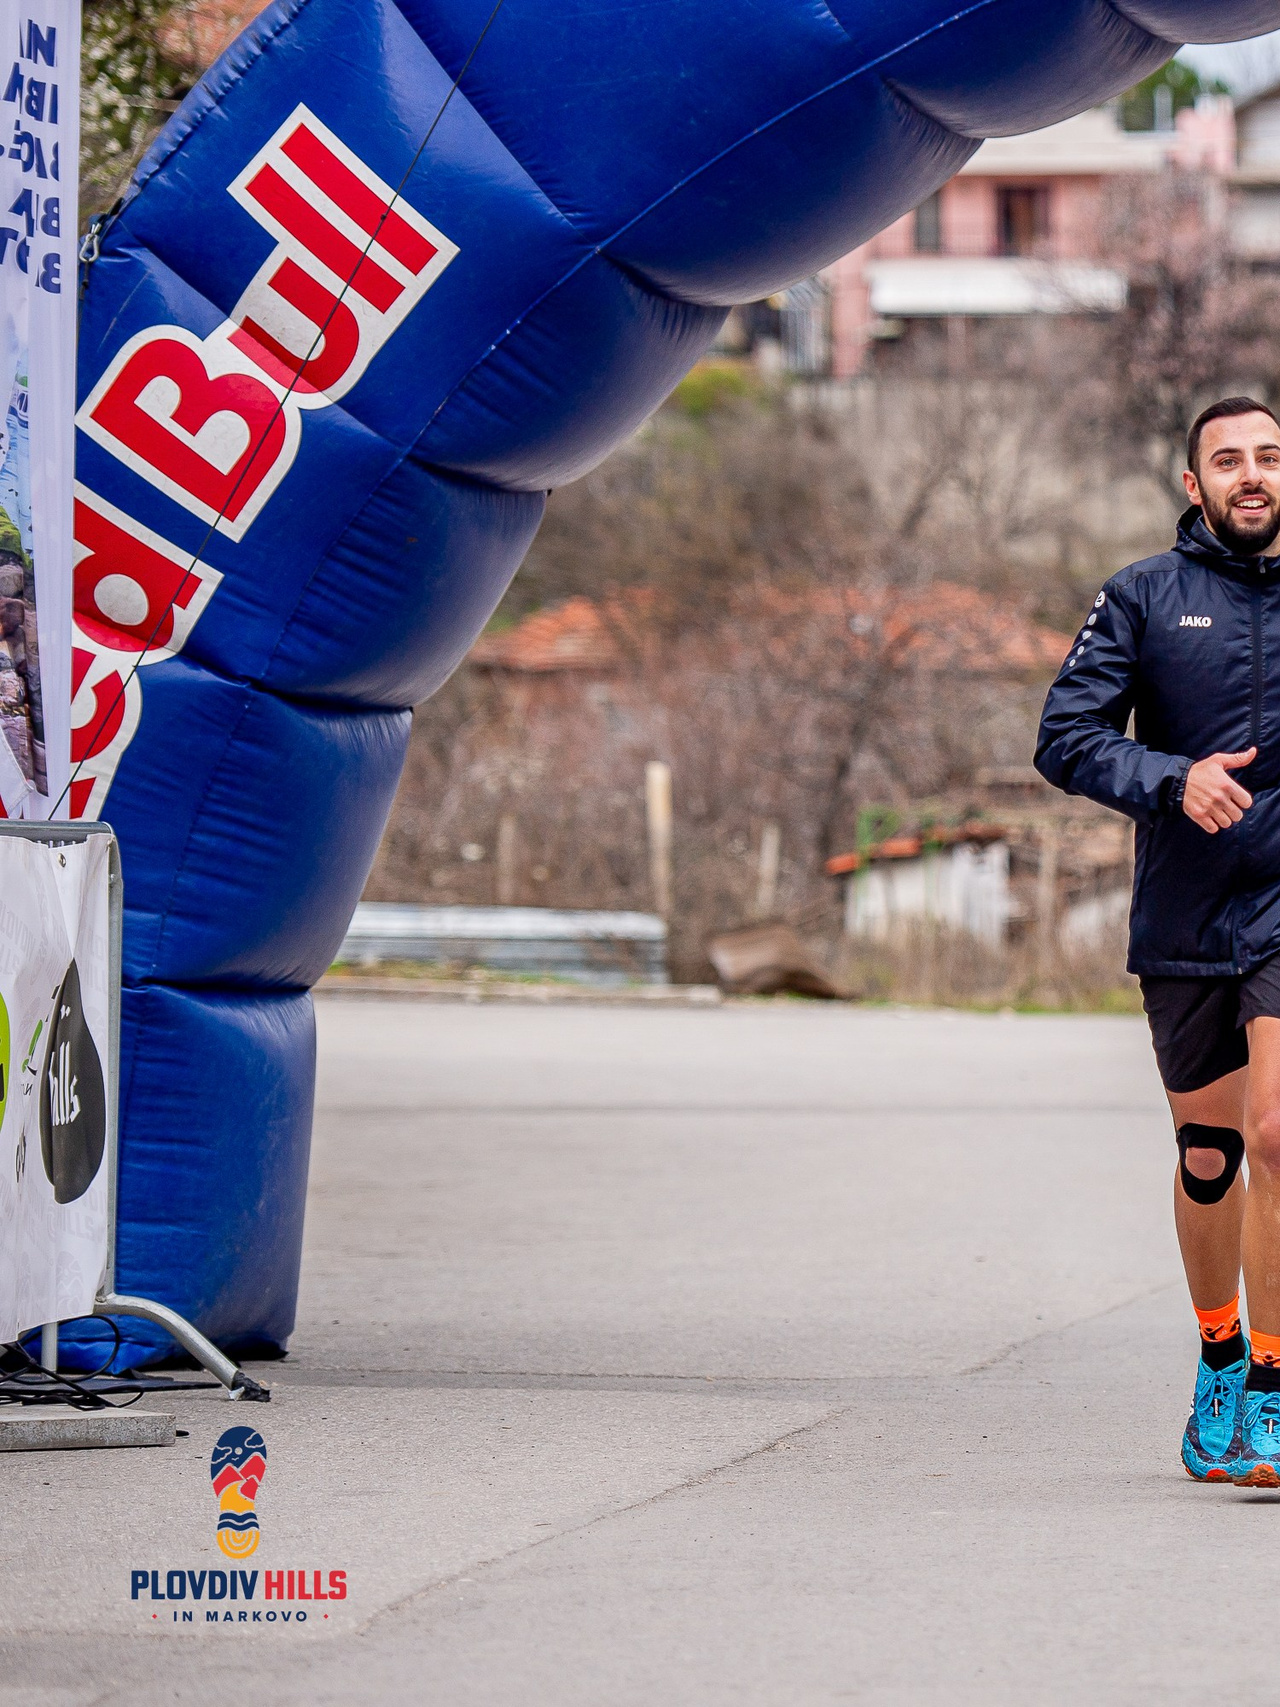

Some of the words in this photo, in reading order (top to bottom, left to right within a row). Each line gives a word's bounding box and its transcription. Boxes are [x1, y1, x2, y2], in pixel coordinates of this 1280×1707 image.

[86, 120, 442, 527] Bull
[70, 498, 204, 818] ed
[1179, 615, 1212, 627] JAKO
